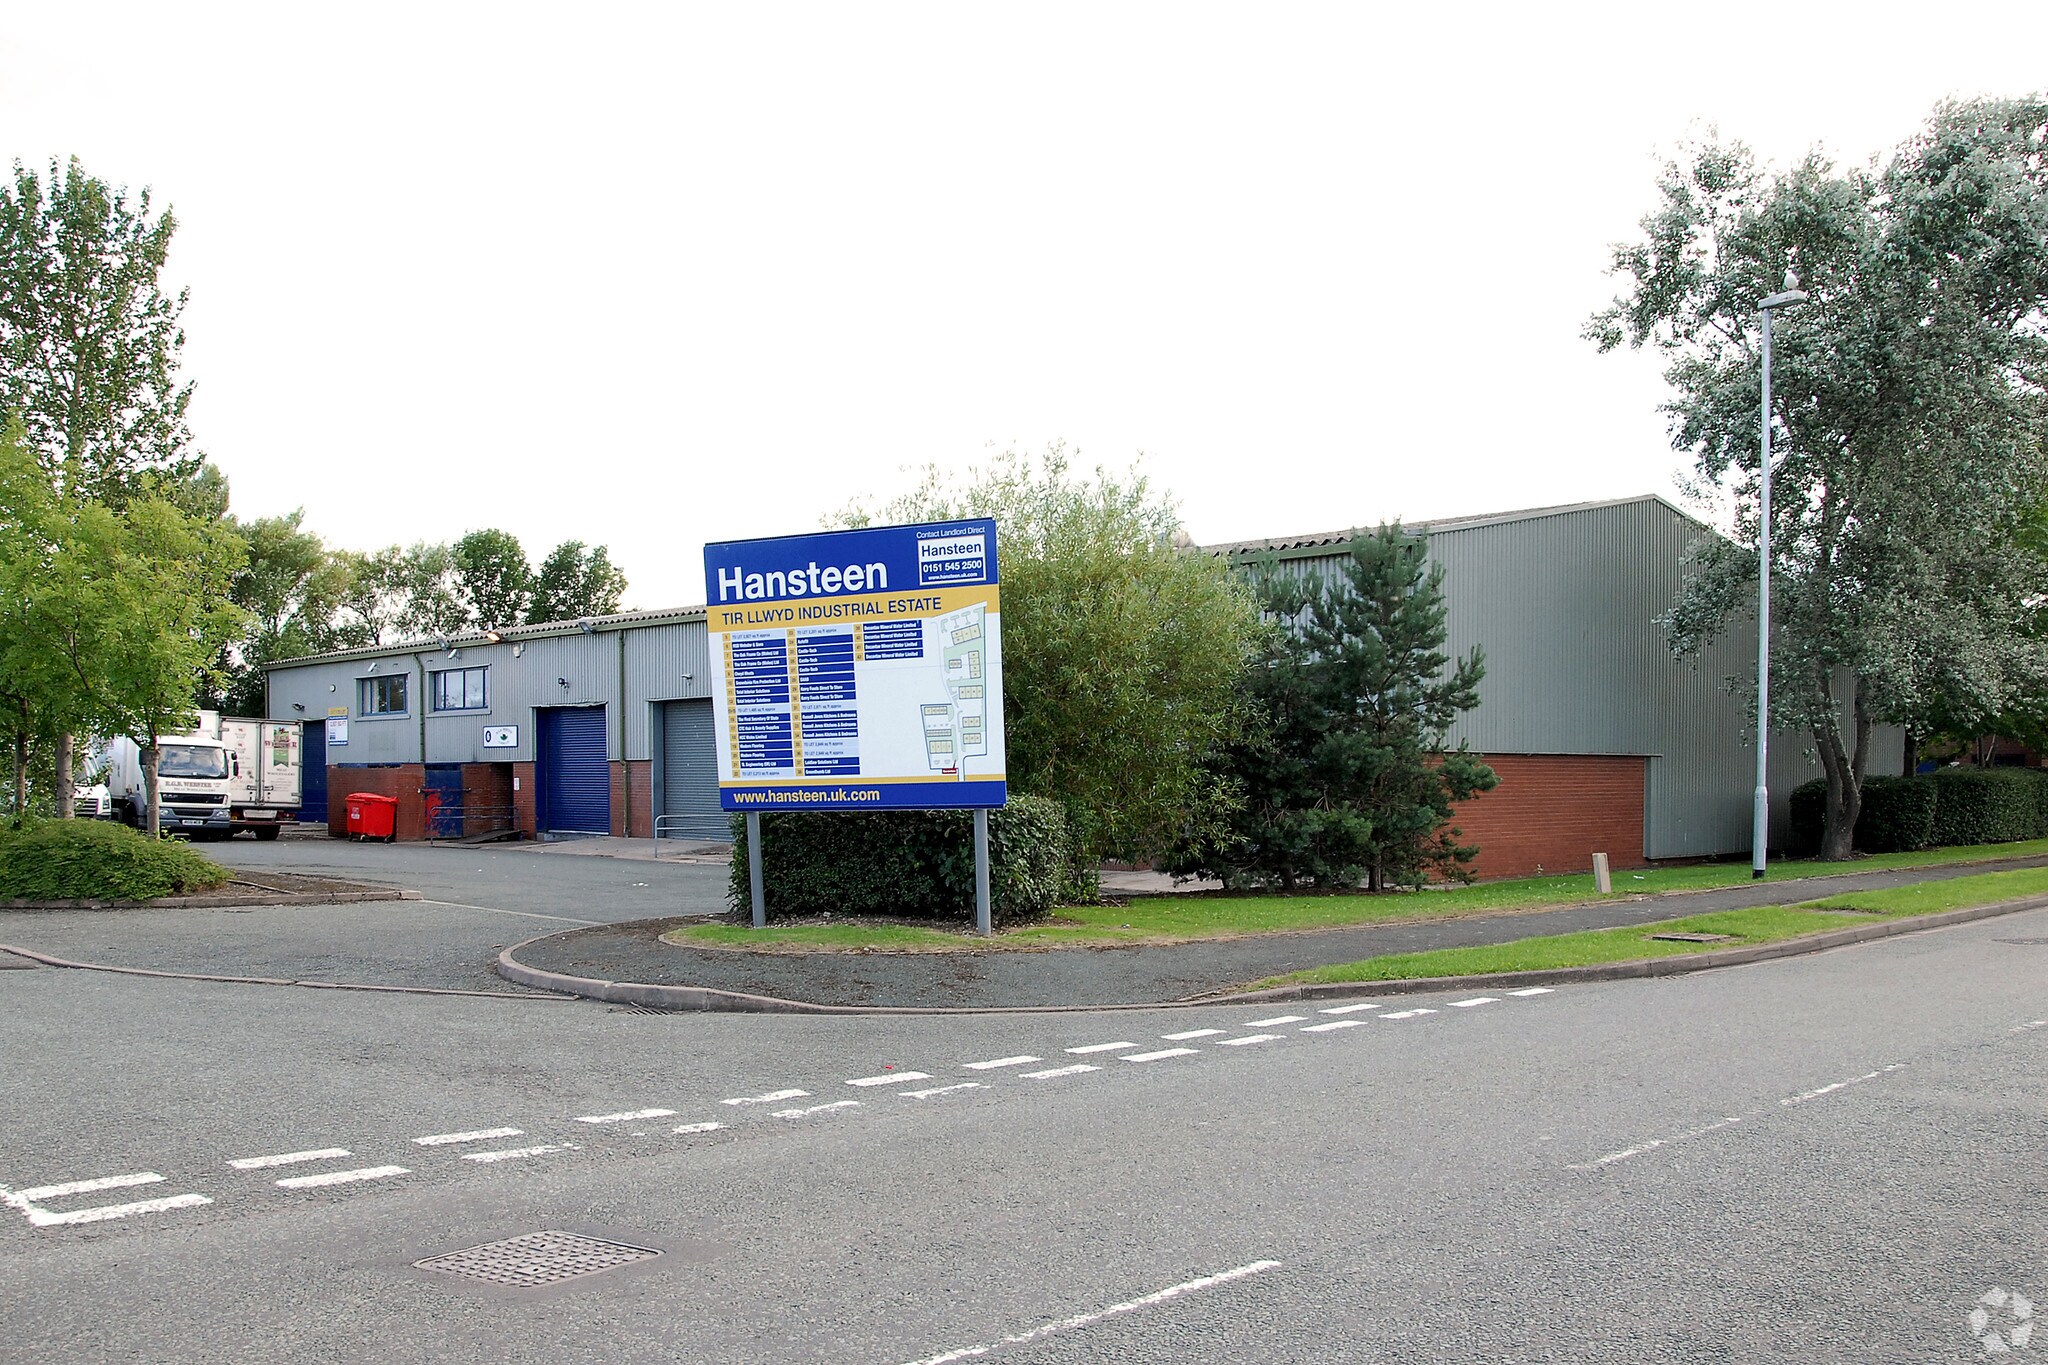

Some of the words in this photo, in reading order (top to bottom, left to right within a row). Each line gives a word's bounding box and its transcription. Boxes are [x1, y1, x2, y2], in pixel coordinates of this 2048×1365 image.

[916, 531, 940, 539] Contact
[941, 528, 966, 537] Landlord
[967, 526, 985, 534] Direct
[921, 543, 982, 557] Hansteen
[923, 563, 942, 573] 0151
[945, 562, 960, 571] 545
[962, 560, 982, 570] 2500
[718, 561, 888, 601] Hansteen
[928, 572, 978, 580] www.hansteen.uk.com
[722, 611, 744, 625] TIR
[747, 605, 794, 623] LLWYD
[798, 601, 884, 620] INDUSTRIAL
[888, 597, 942, 613] ESTATE
[733, 788, 880, 803] www.hansteen.uk.com
